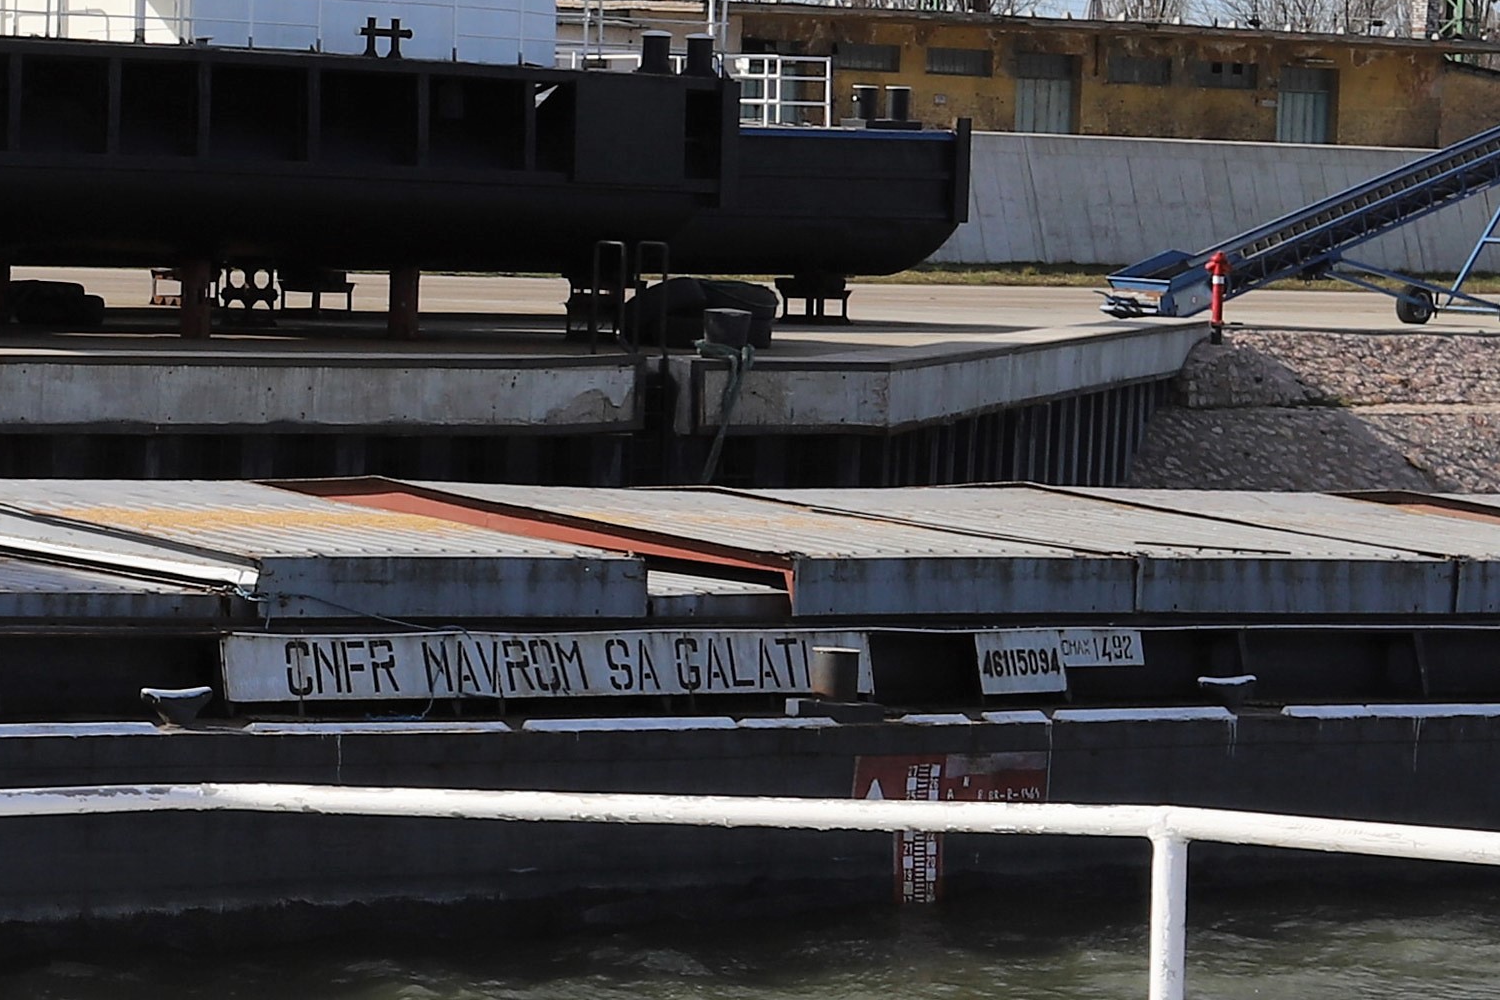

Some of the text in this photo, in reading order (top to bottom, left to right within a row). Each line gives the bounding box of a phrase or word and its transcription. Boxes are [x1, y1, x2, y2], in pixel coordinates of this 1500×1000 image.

[983, 647, 1061, 678] 46115094
[1093, 635, 1134, 662] 1492
[286, 637, 812, 696] CNFR NAVROM SA GALATI
